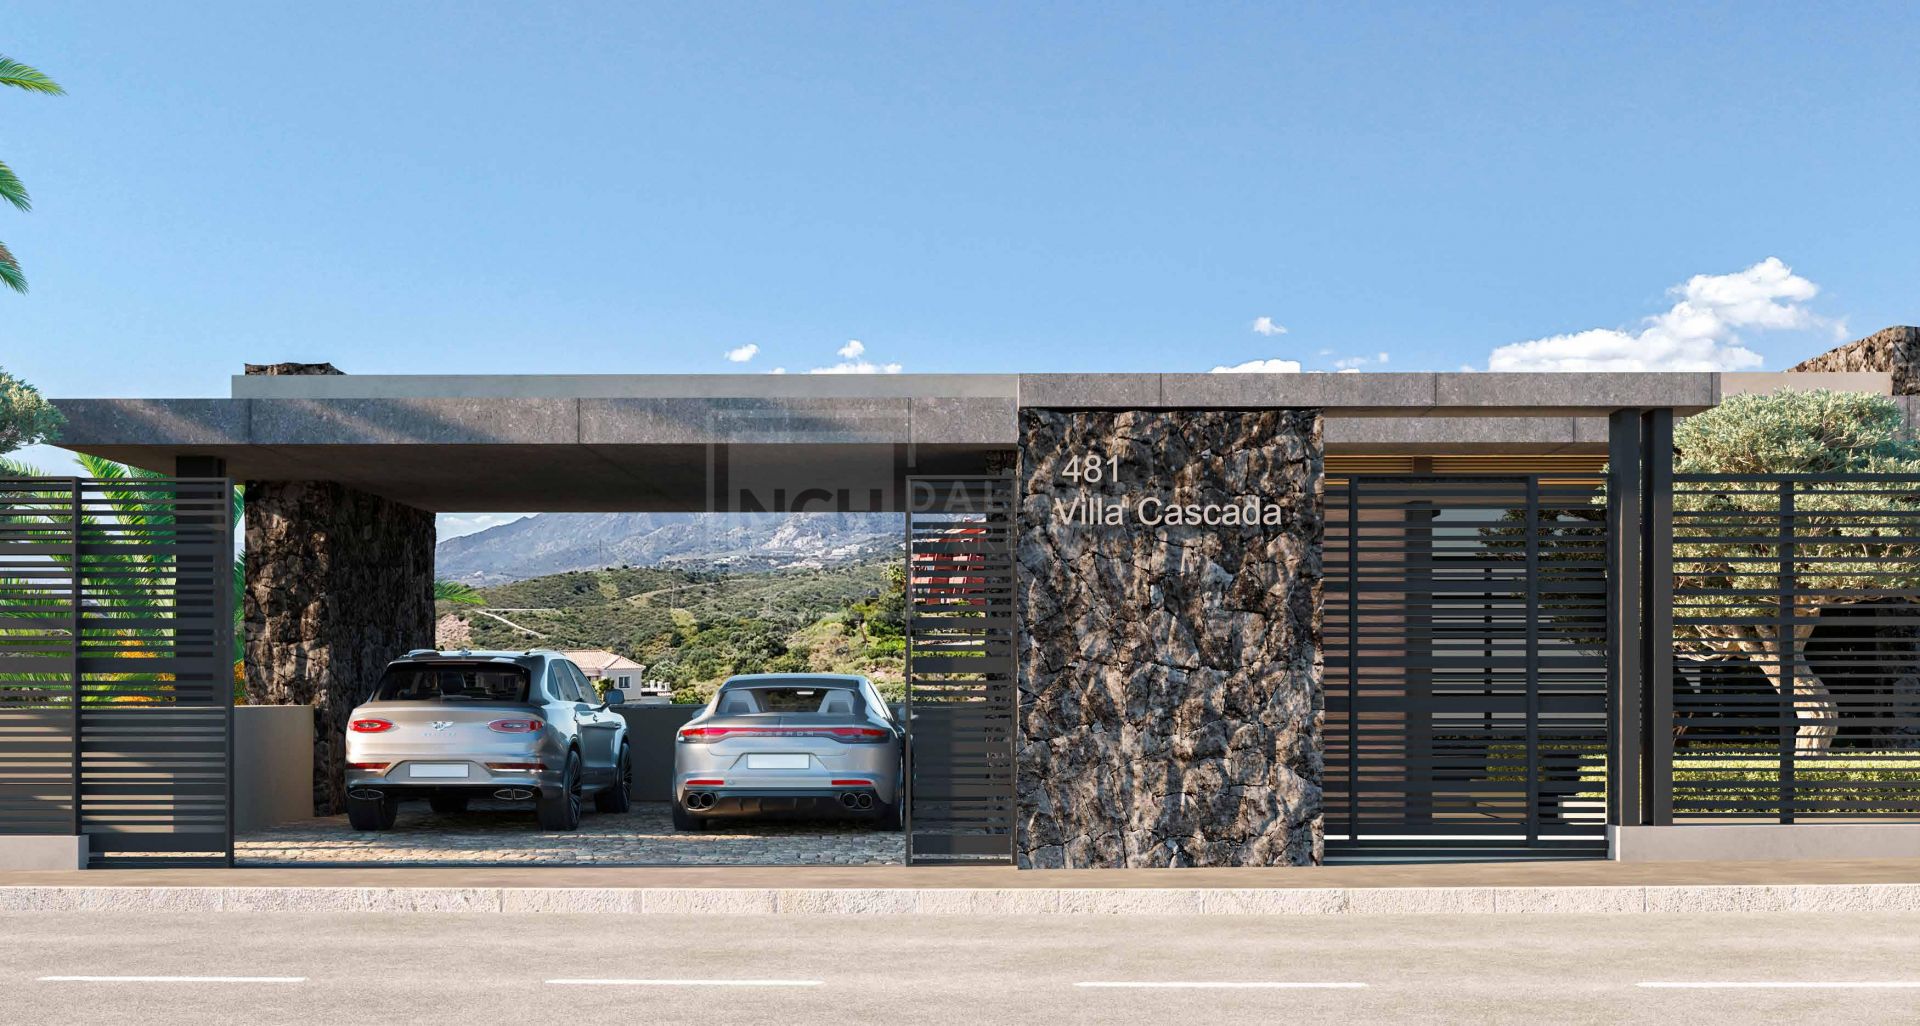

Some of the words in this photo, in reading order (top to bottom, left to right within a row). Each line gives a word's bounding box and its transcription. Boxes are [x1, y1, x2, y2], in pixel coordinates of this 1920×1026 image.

[1062, 454, 1119, 483] 481
[1055, 497, 1124, 526] Villa
[1138, 496, 1282, 526] Cascada
